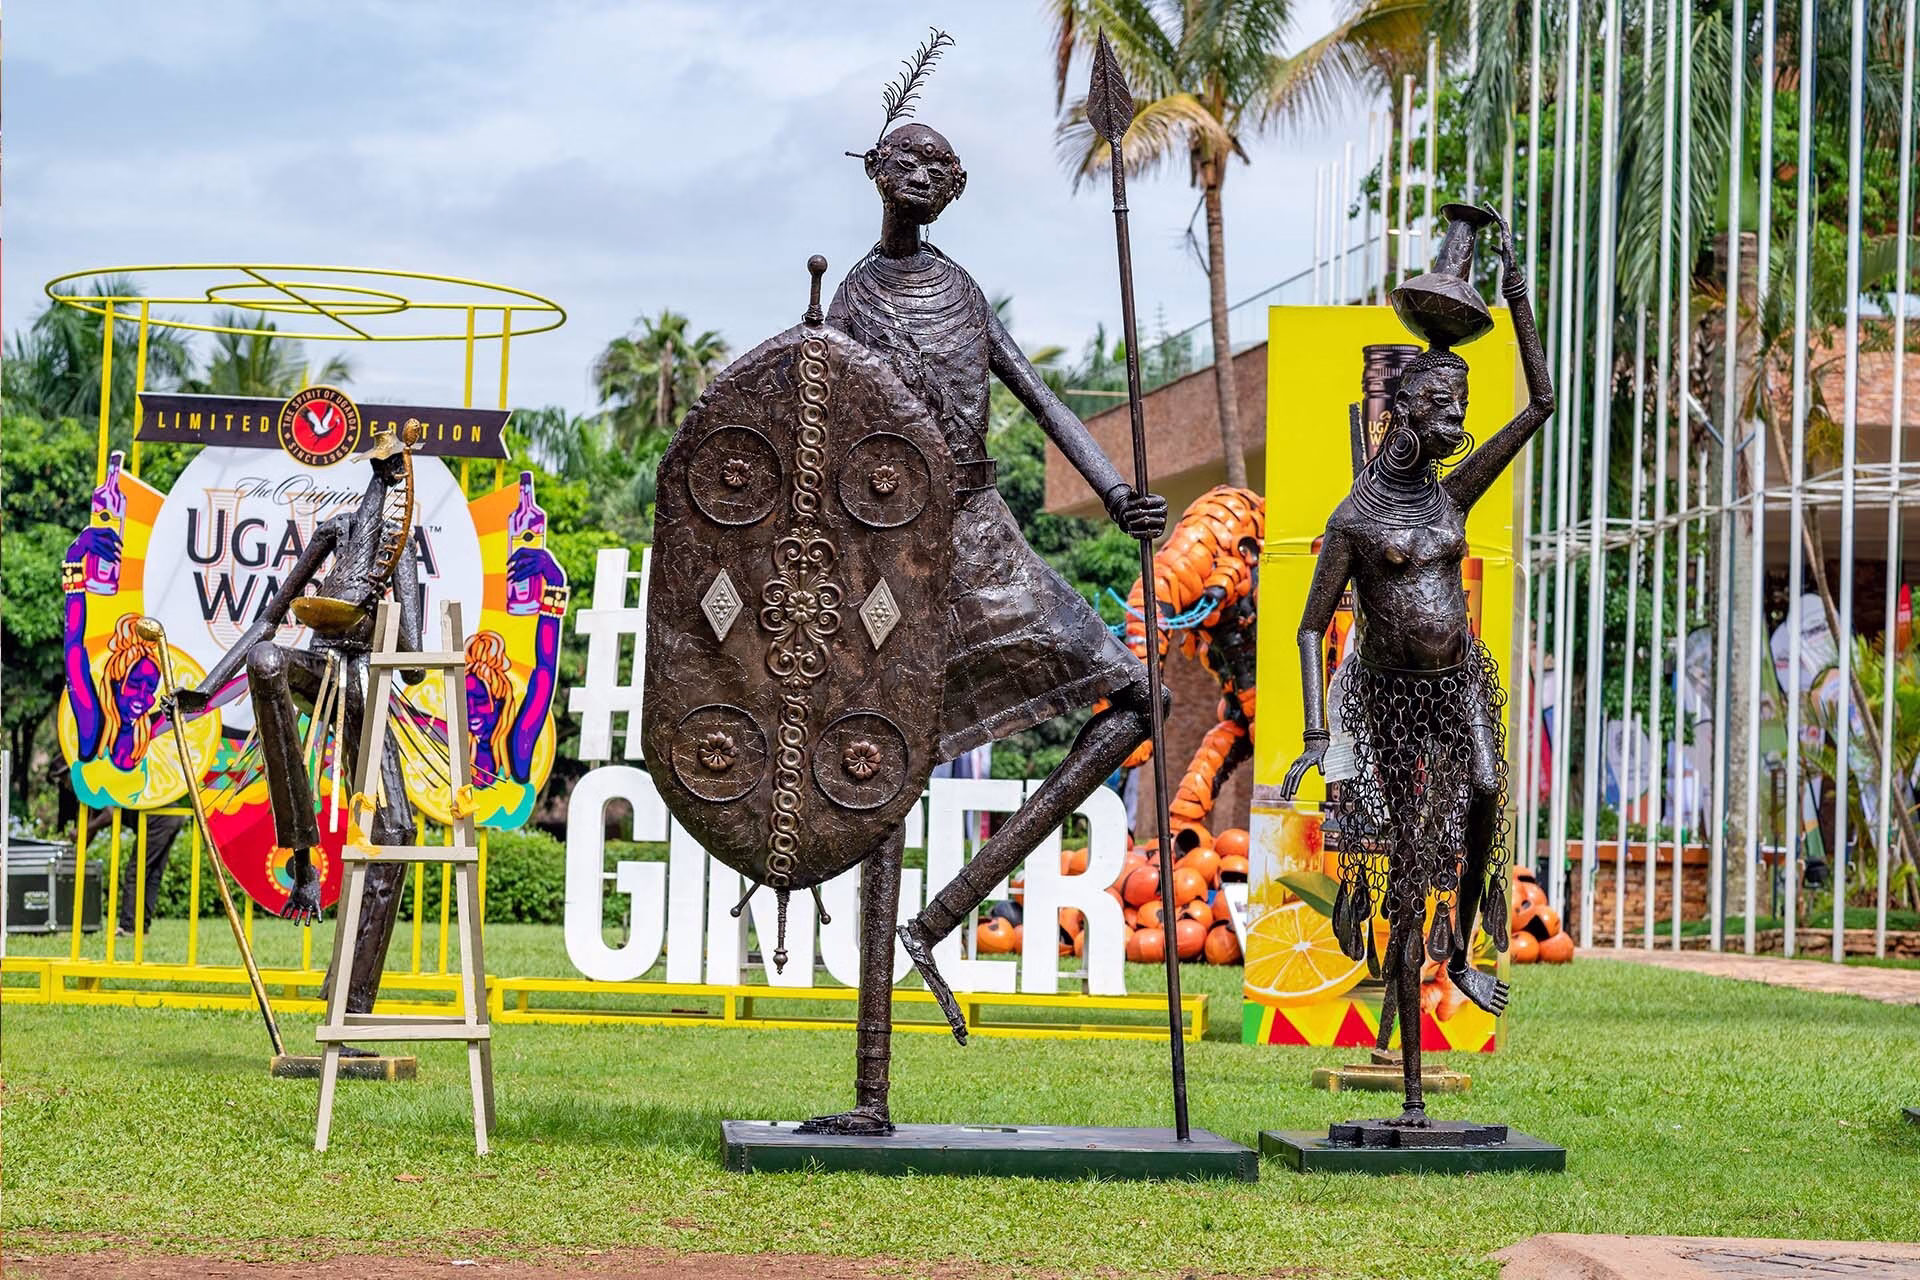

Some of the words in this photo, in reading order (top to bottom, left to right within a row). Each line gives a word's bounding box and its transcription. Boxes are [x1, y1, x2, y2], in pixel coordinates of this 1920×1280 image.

[158, 411, 270, 432] LIMITED
[369, 421, 482, 442] EDTION
[283, 409, 294, 428] THE
[291, 390, 321, 409] SPIRIT
[324, 390, 336, 400] OF
[336, 395, 357, 431] UGANDA
[288, 442, 318, 465] SINCE
[323, 444, 349, 465] 1965
[234, 477, 272, 499] The
[272, 474, 365, 515] Origin
[187, 508, 439, 578] UGAA
